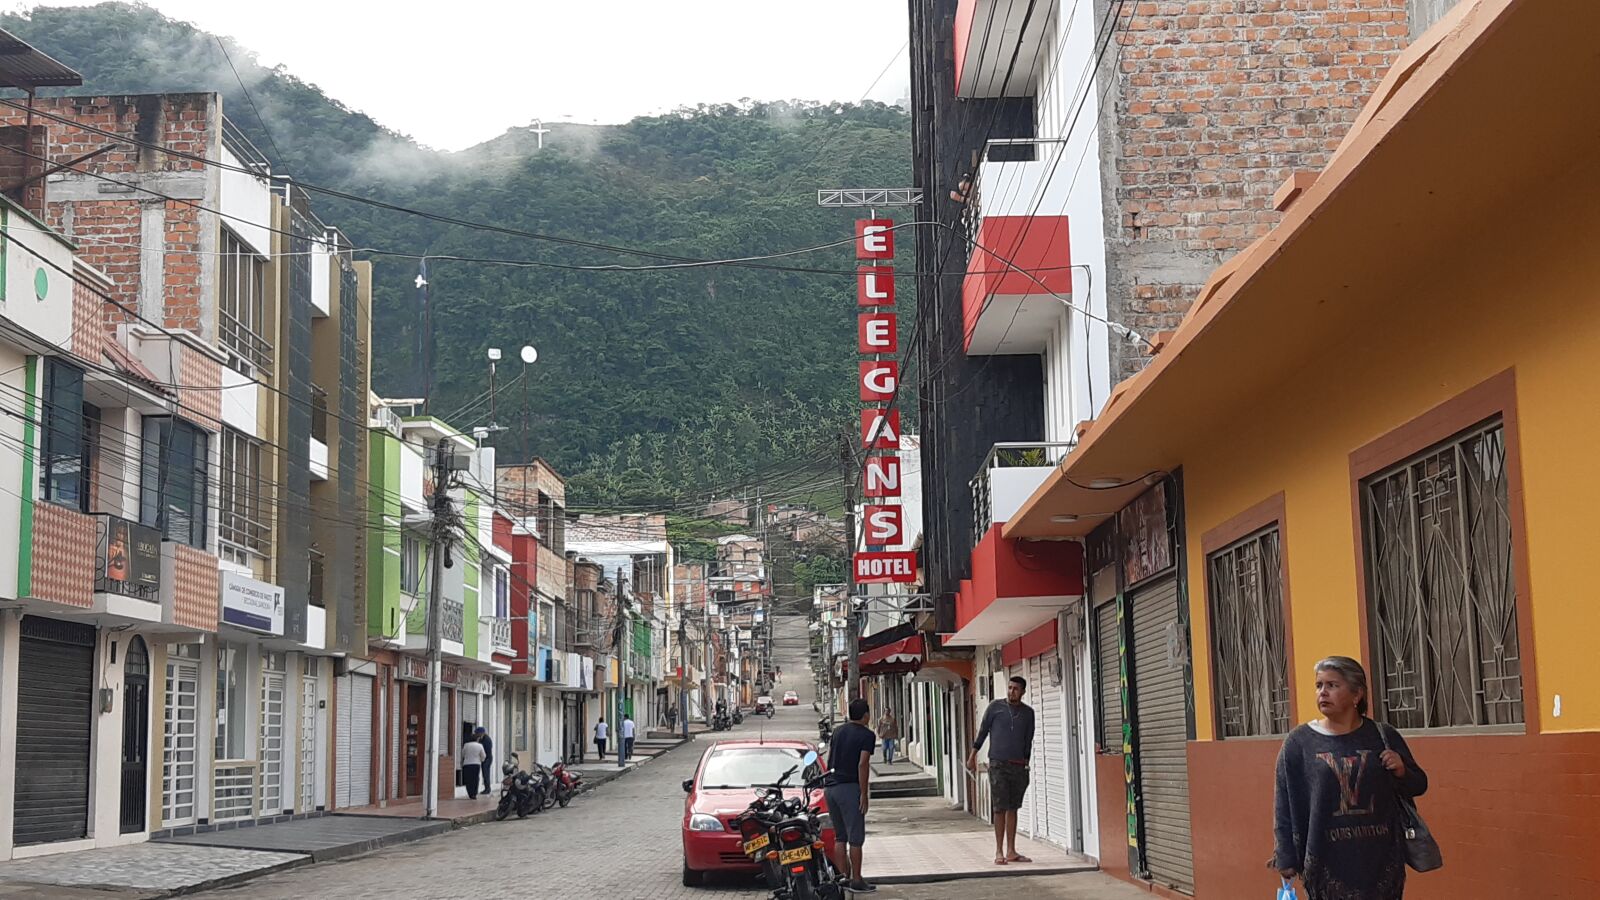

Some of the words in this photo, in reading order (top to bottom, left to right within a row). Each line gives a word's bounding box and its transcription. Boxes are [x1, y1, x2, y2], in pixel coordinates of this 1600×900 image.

[863, 225, 898, 539] ELEGANS
[857, 557, 912, 577] HOTEL
[1116, 593, 1128, 718] PLAY
[1123, 723, 1137, 848] ZONE
